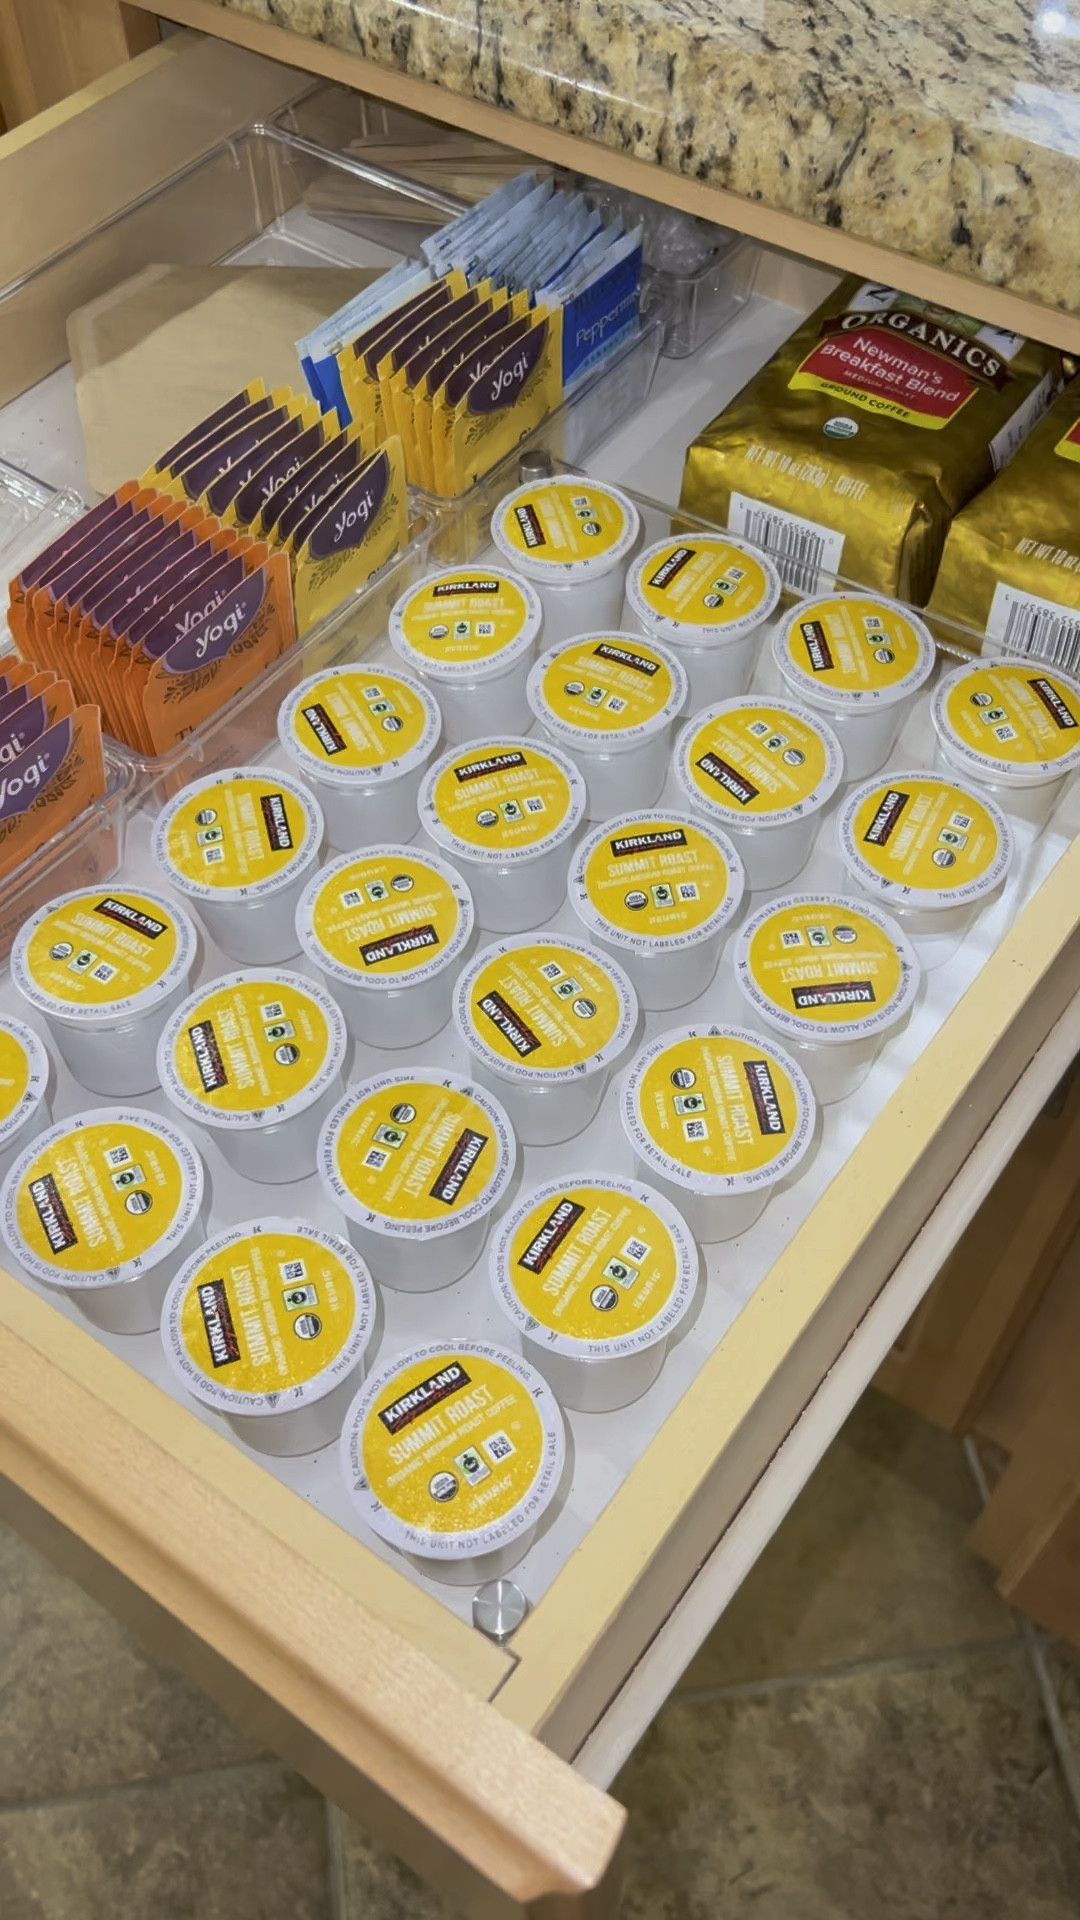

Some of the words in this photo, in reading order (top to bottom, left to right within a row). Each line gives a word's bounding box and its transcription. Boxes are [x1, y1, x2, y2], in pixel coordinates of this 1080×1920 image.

[841, 311, 1001, 378] ORGANICS
[852, 336, 944, 385] Newman's
[491, 351, 529, 401] yogi
[819, 344, 904, 385] Breakfast
[905, 378, 961, 402] Blend
[843, 370, 883, 388] MEDIUM
[820, 382, 868, 402] GROUND
[868, 399, 911, 418] COFFEE
[744, 444, 766, 464] NET
[762, 449, 780, 468] WT
[777, 455, 792, 473] 10
[834, 474, 870, 501] COFFEE
[333, 490, 375, 543] yogi
[650, 548, 688, 584] KIRKLAND
[1014, 537, 1038, 555] NET
[1034, 542, 1056, 561] WT
[1051, 548, 1068, 566] 10
[438, 581, 495, 591] KIRKLAND
[196, 603, 246, 658] yogi
[803, 623, 824, 670] KIRKLAND
[600, 645, 656, 669] KIRKLAND
[1037, 679, 1074, 727] KIRKLAND
[304, 706, 338, 752] KIRKLAND
[458, 752, 521, 775] KIRKLAND
[712, 735, 747, 762] ROAST
[453, 777, 501, 799] SUMMIT
[502, 767, 540, 786] ROAST
[698, 756, 751, 801] KIRKLAND
[739, 759, 783, 793] SUMMIT
[269, 797, 291, 847] KIRKLAND
[866, 791, 900, 840] KIRKLAND
[615, 830, 682, 849] KIRKLAND
[606, 856, 656, 876] SUMMIT
[659, 849, 699, 867] ROAST
[102, 900, 164, 932] KIRKLAND
[343, 918, 385, 942] ROAST
[386, 903, 437, 929] SUMMIT
[72, 912, 119, 938] SUMMIT
[111, 932, 155, 958] ROAST
[363, 931, 435, 962] KIRKLAND
[778, 966, 821, 982] ROAST
[824, 961, 878, 978] SUMMIT
[498, 973, 534, 1007] ROAST
[797, 989, 870, 1007] KIRKLAND
[216, 1006, 241, 1042] ROAST
[479, 995, 532, 1052] KIRKLAND
[524, 1004, 568, 1047] SUMMIT
[191, 1025, 218, 1087] KIRKLAND
[226, 1042, 255, 1090] SUMMIT
[633, 1055, 649, 1072] UNIT
[645, 1041, 664, 1057] THIS
[353, 1085, 371, 1099] NOT
[371, 1077, 392, 1090] UNIT
[394, 1074, 414, 1082] THIS
[627, 1072, 638, 1088] NOT
[716, 1054, 743, 1101] SUMMIT
[328, 1097, 355, 1129] LABELED
[625, 1091, 638, 1125] LABELED
[754, 1064, 781, 1131] KIRKLAND
[324, 1130, 335, 1145] FOR
[425, 1110, 462, 1159] SUMMIT
[632, 1127, 647, 1143] FOR
[729, 1105, 754, 1144] ROAST
[323, 1149, 335, 1176] RETAIL
[440, 1137, 483, 1198] KIRKLAND
[643, 1143, 670, 1167] RETAIL
[669, 1162, 692, 1178] SALE
[57, 1155, 87, 1196] ROAST
[329, 1176, 346, 1196] SALE
[403, 1156, 435, 1195] ROAST
[32, 1180, 67, 1249] KIRKLAND
[72, 1194, 107, 1248] SUMMIT
[296, 1225, 319, 1238] SALE
[320, 1232, 347, 1255] RETAIL
[521, 1200, 575, 1266] KIRKLAND
[668, 1222, 684, 1243] SALE
[344, 1252, 360, 1270] FOR
[541, 1243, 585, 1297] SUMMIT
[575, 1206, 612, 1247] ROAST
[678, 1245, 689, 1274] RETAIL
[230, 1262, 257, 1307] ROAST
[356, 1270, 370, 1309] LABELED
[677, 1276, 690, 1295] FOR
[200, 1283, 228, 1362] KIRKLAND
[358, 1312, 369, 1331] NOT
[654, 1296, 685, 1331] LABELED
[240, 1308, 271, 1367] SUMMIT
[347, 1333, 364, 1355] UNIT
[588, 1344, 609, 1353] THIS
[613, 1338, 636, 1351] UNIT
[636, 1327, 657, 1343] NOT
[330, 1354, 350, 1376] THIS
[352, 1406, 365, 1428] POD
[360, 1397, 370, 1407] IS
[381, 1353, 414, 1379] ALLOW
[413, 1347, 428, 1358] TO
[427, 1342, 455, 1354] COOL
[458, 1342, 496, 1357] BEFORE
[383, 1364, 462, 1423] KIRKLAND
[387, 1413, 448, 1465] SUMMIT
[445, 1383, 495, 1425] ROAST
[403, 1529, 426, 1546] THIS
[429, 1539, 453, 1549] UNIT
[458, 1537, 478, 1549] NOT
[481, 1513, 525, 1544] LABELED
[522, 1495, 541, 1515] FOR
[535, 1459, 556, 1494] RETAIL
[546, 1431, 556, 1456] SALE
